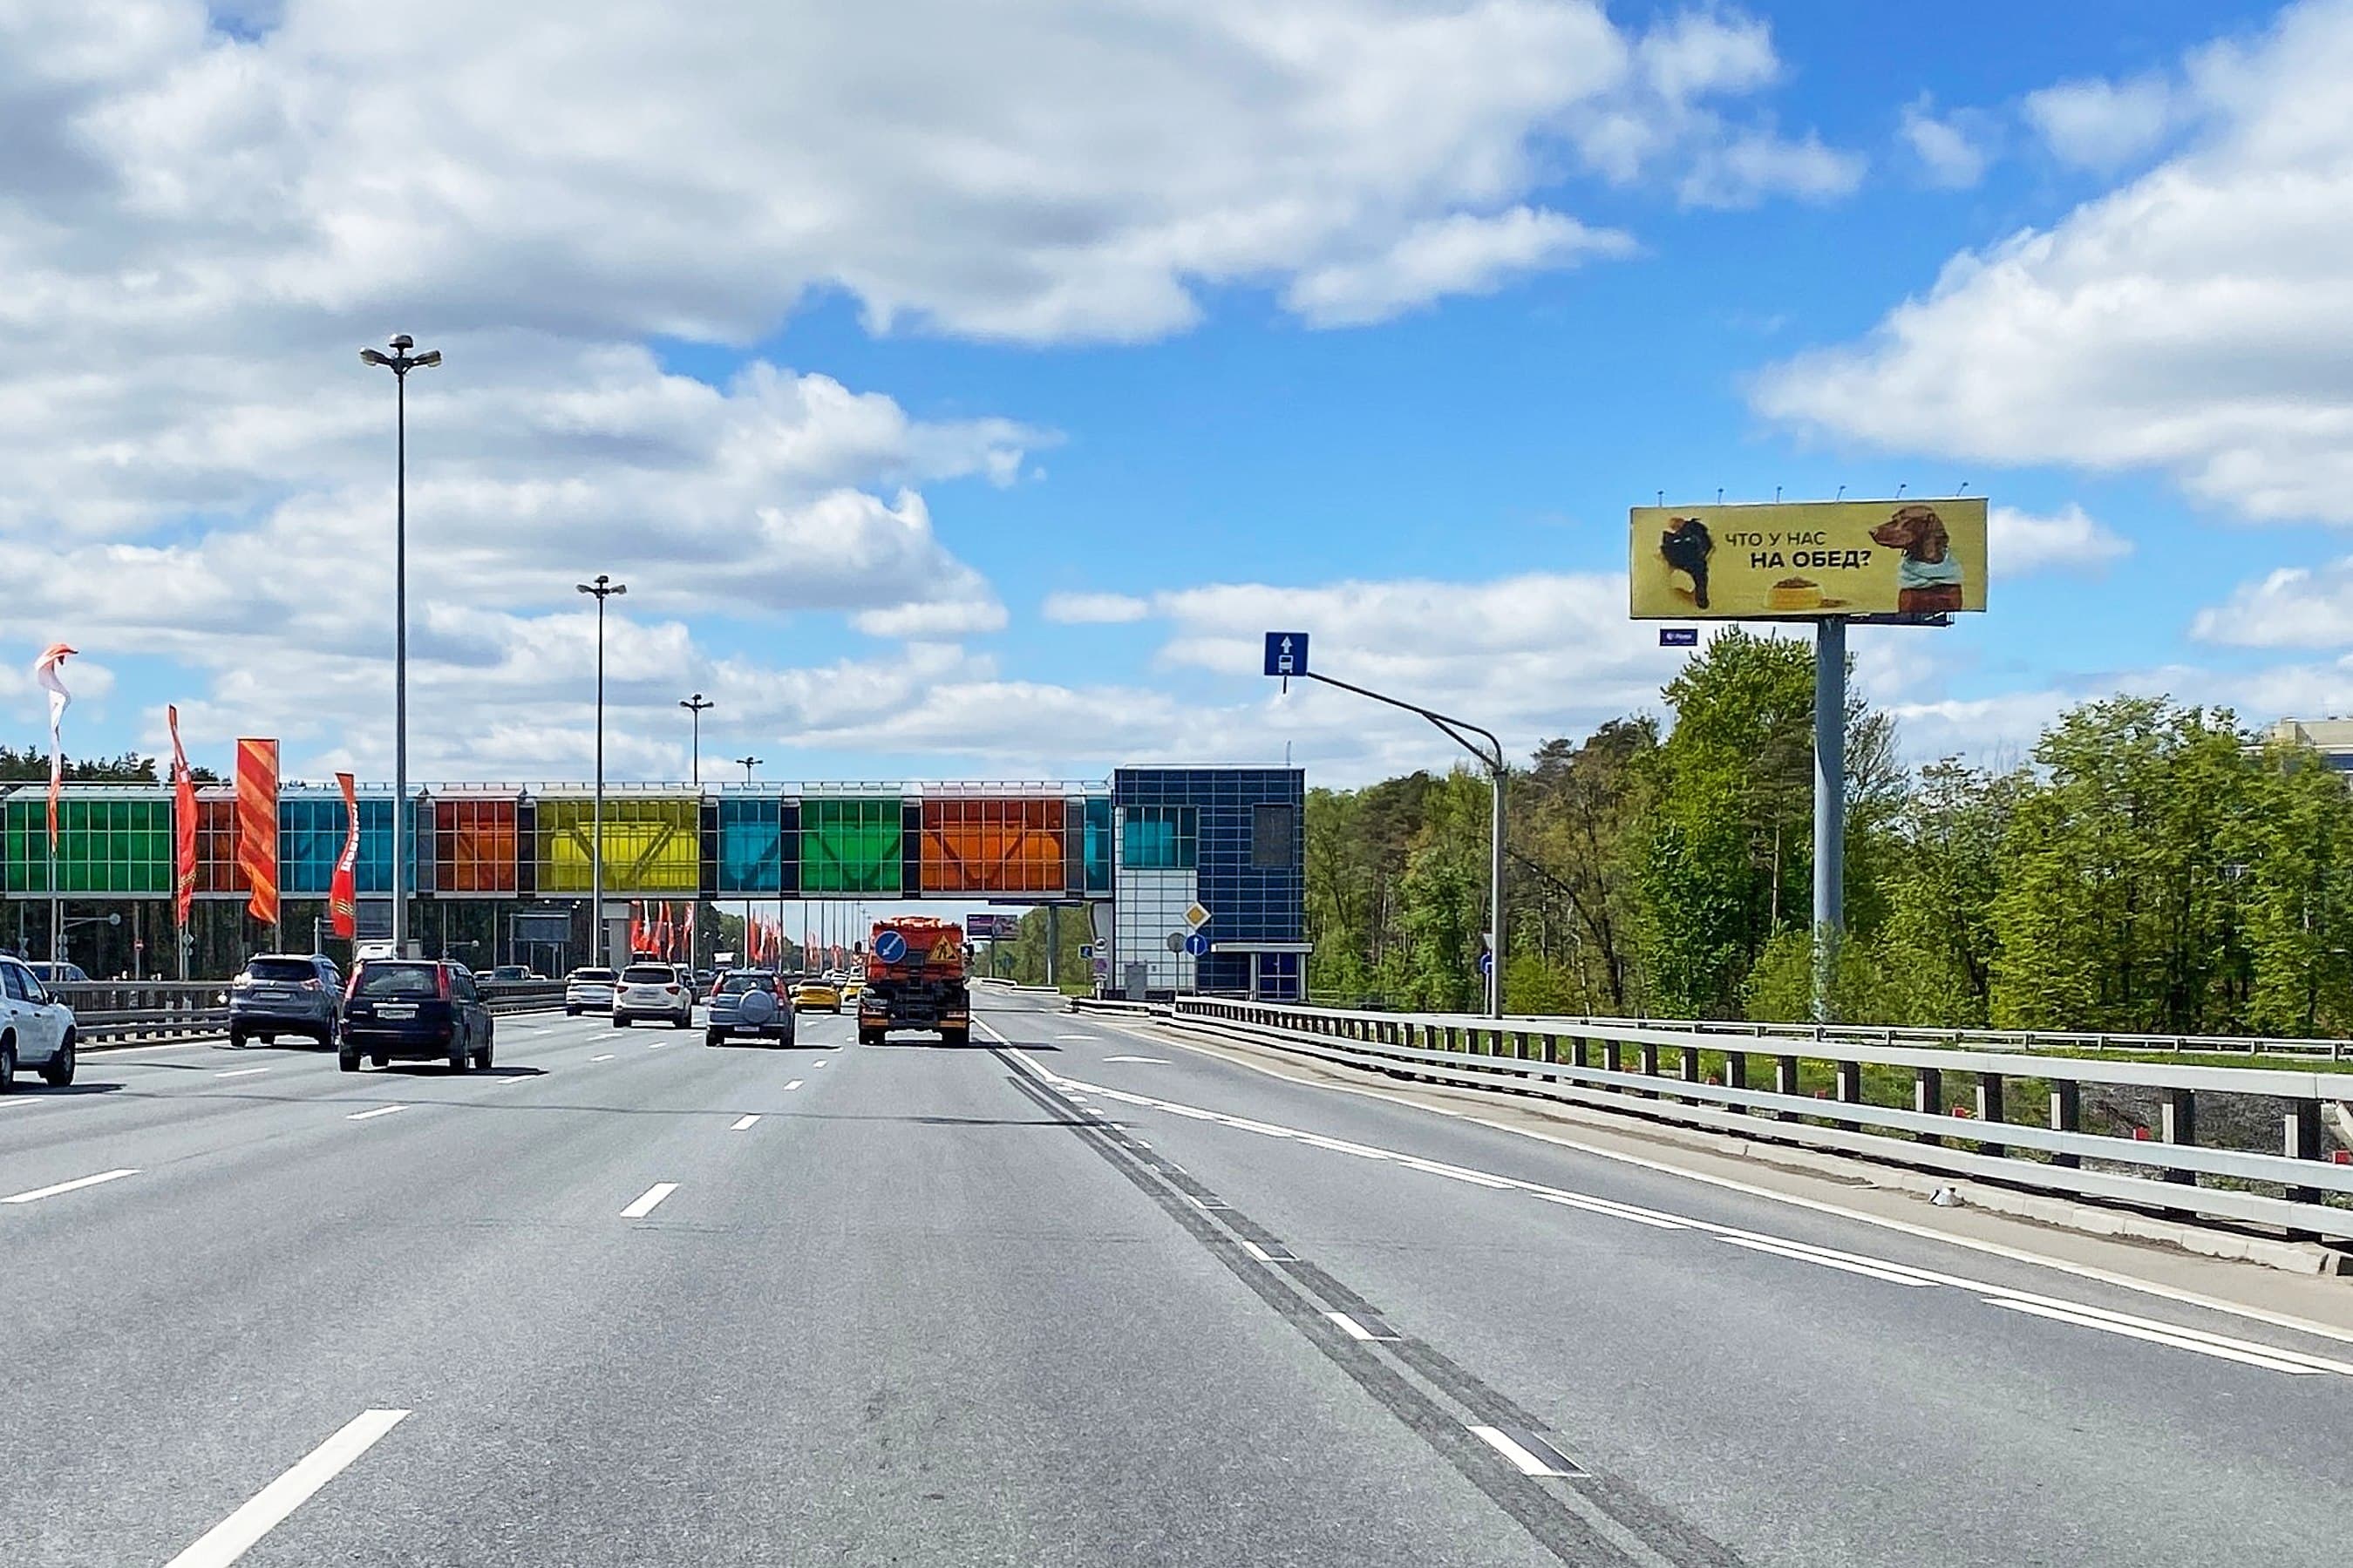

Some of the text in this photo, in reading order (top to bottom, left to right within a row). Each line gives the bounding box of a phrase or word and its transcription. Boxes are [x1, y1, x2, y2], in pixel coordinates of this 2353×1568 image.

[1725, 531, 1827, 546] ЧТО У НАС
[1751, 550, 1872, 569] НА ОБЕД?
